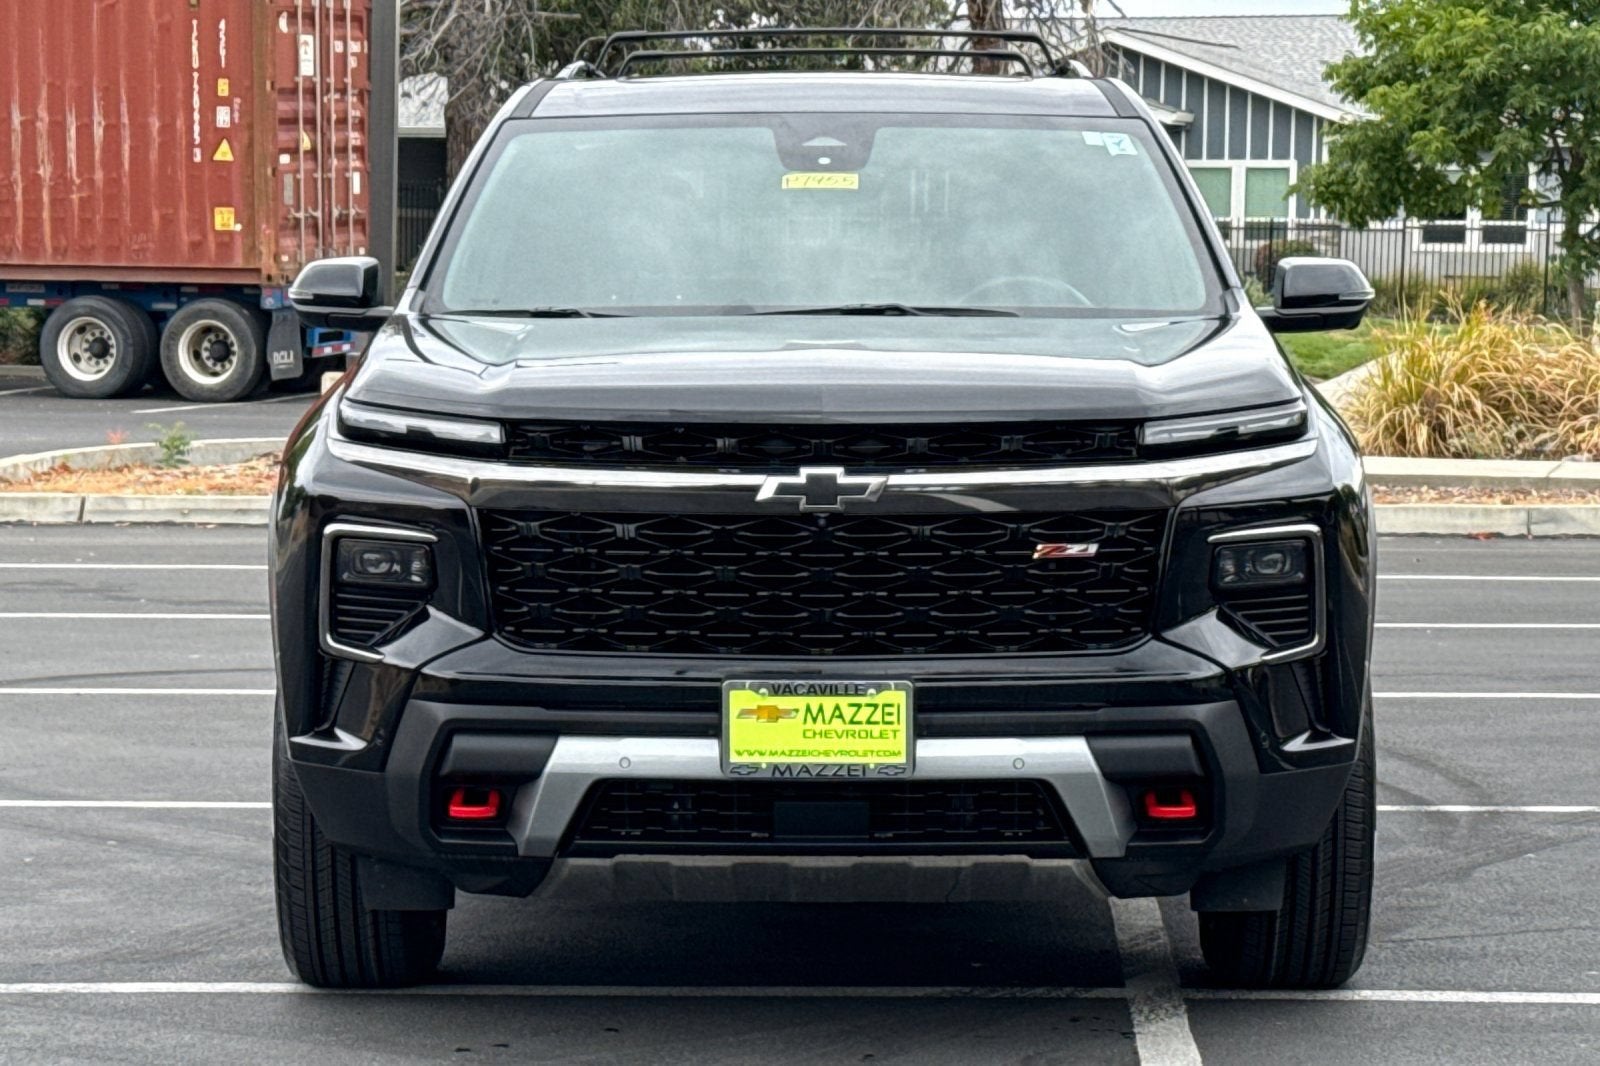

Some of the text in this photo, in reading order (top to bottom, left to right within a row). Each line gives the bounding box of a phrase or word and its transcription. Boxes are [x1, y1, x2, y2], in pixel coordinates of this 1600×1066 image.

[771, 683, 866, 696] VACAVILLE
[803, 702, 901, 725] MAZZEI
[802, 728, 900, 740] CHEVROLET
[771, 763, 866, 777] MAZZEI
